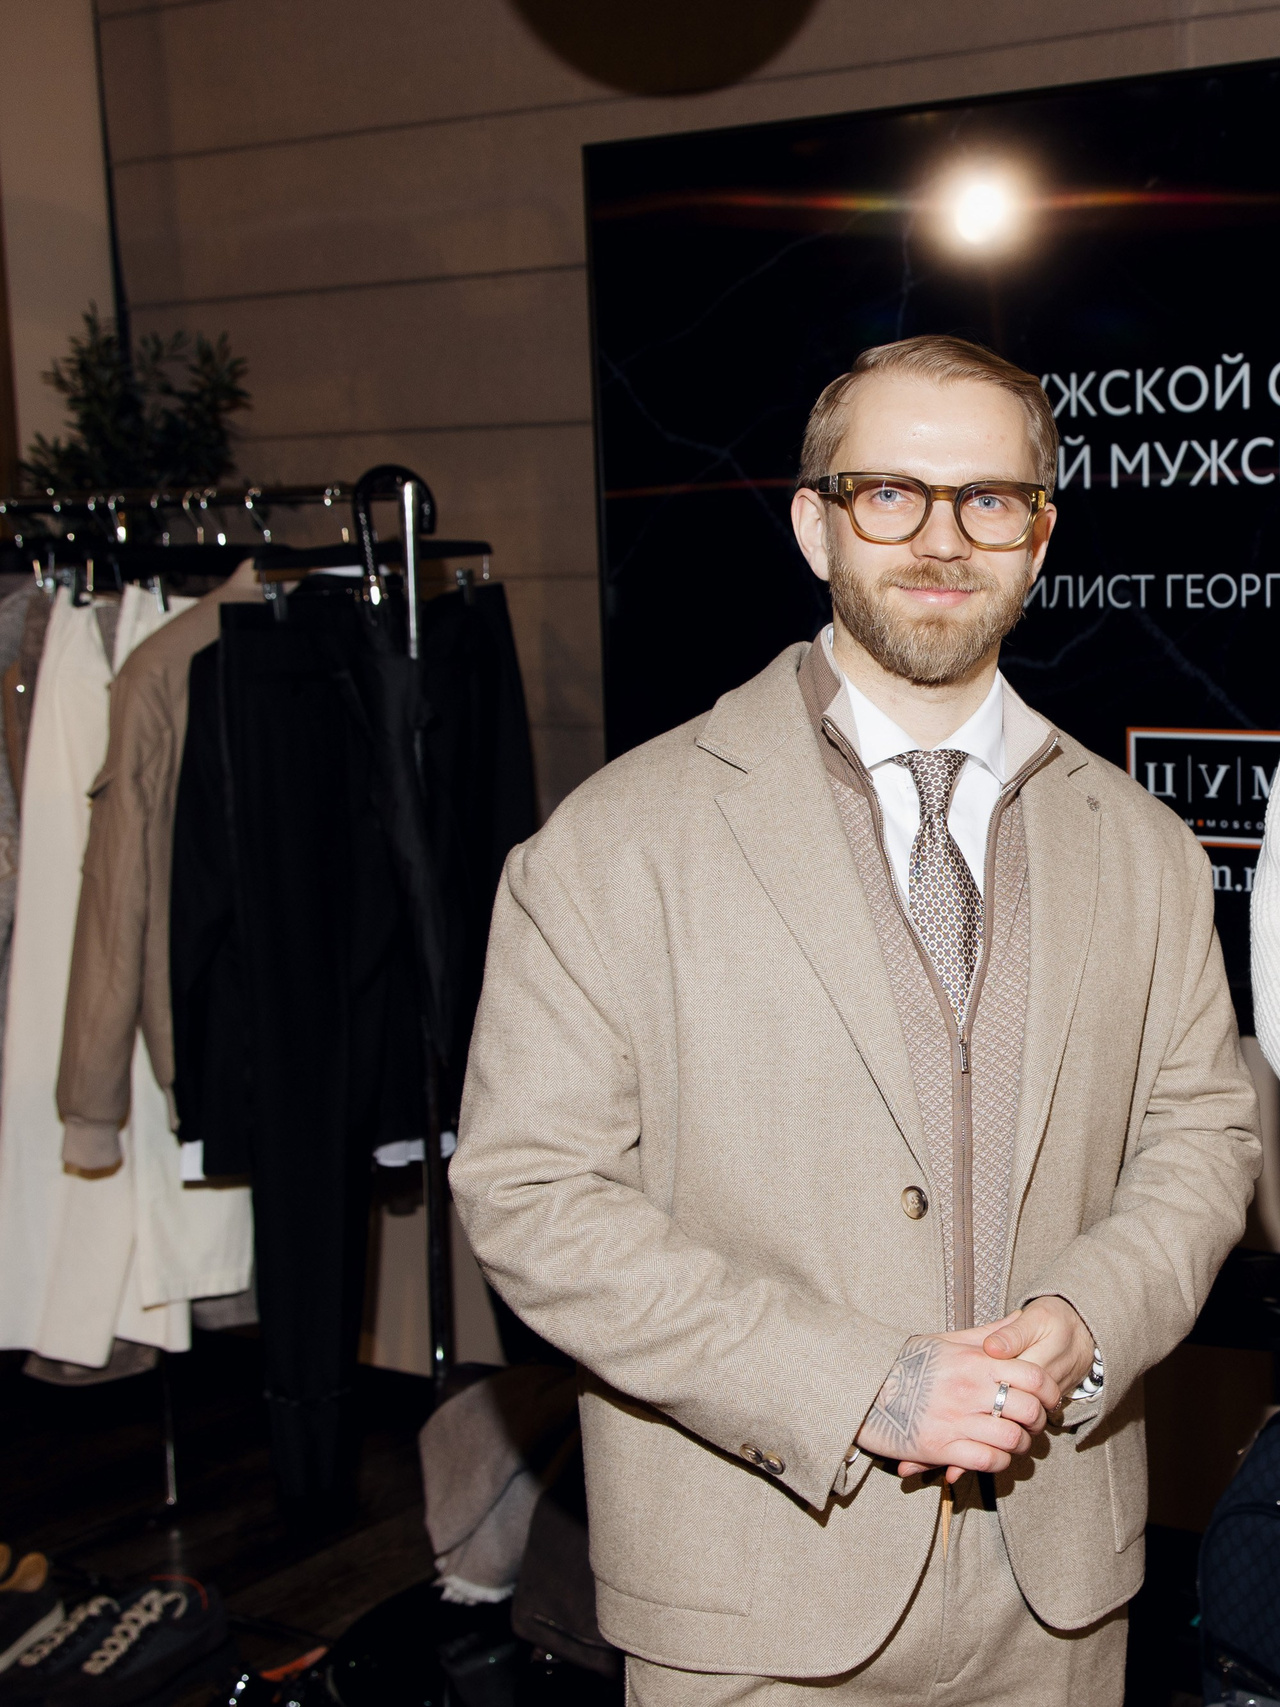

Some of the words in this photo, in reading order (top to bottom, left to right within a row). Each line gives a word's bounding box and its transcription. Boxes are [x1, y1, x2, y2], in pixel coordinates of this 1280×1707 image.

[1041, 353, 1251, 418] ЖСКОЙ
[1023, 574, 1155, 609] ИЛИСТ
[1206, 819, 1265, 831] MOSCO
